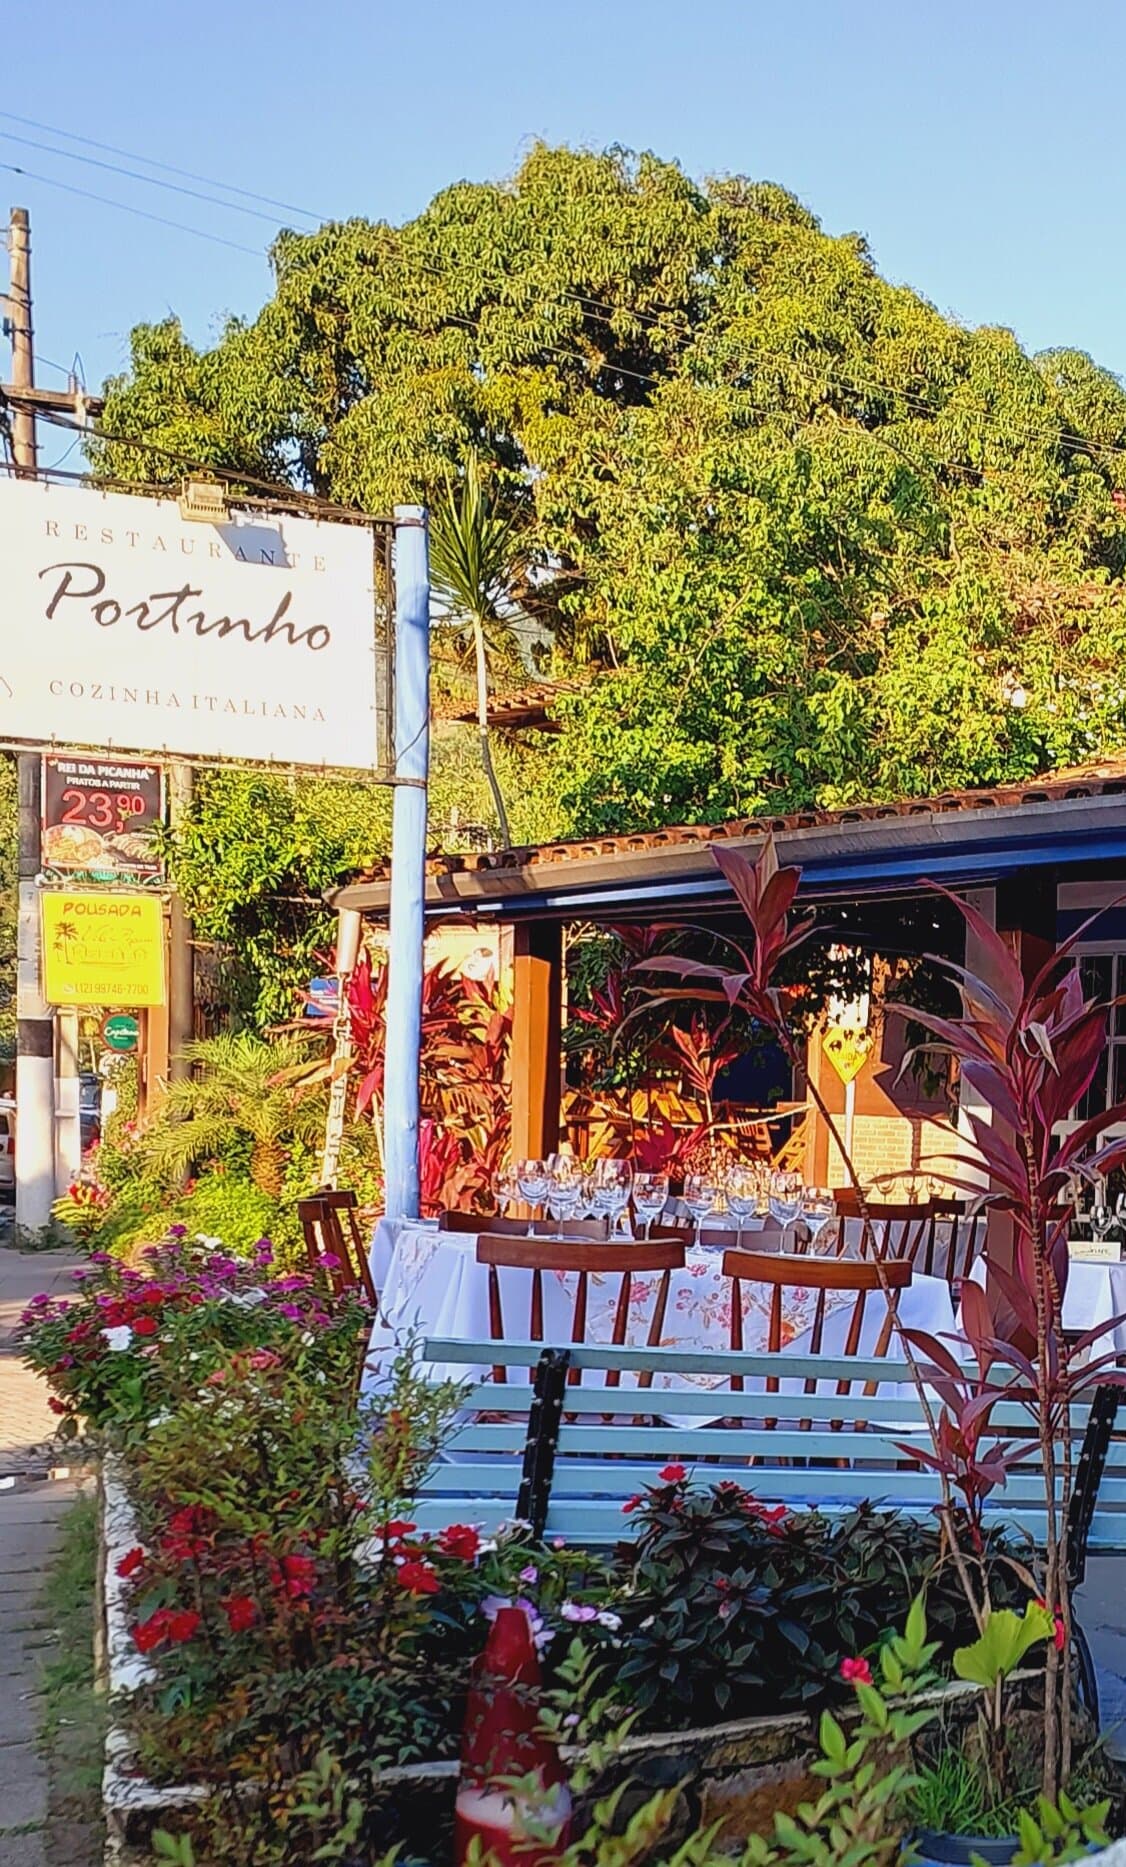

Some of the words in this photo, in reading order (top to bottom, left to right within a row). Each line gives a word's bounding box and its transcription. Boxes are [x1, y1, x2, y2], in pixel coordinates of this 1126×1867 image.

[45, 519, 327, 573] RESTAURANTE
[38, 562, 331, 651] Portinho
[49, 680, 182, 708] COZINHA
[191, 694, 327, 723] ITALIANA
[57, 763, 76, 773] REI
[78, 764, 96, 775] DA
[98, 765, 149, 780] PICANHA
[66, 776, 101, 787] PRATOS
[109, 780, 140, 790] PARTIR
[63, 902, 142, 917] POUSADA
